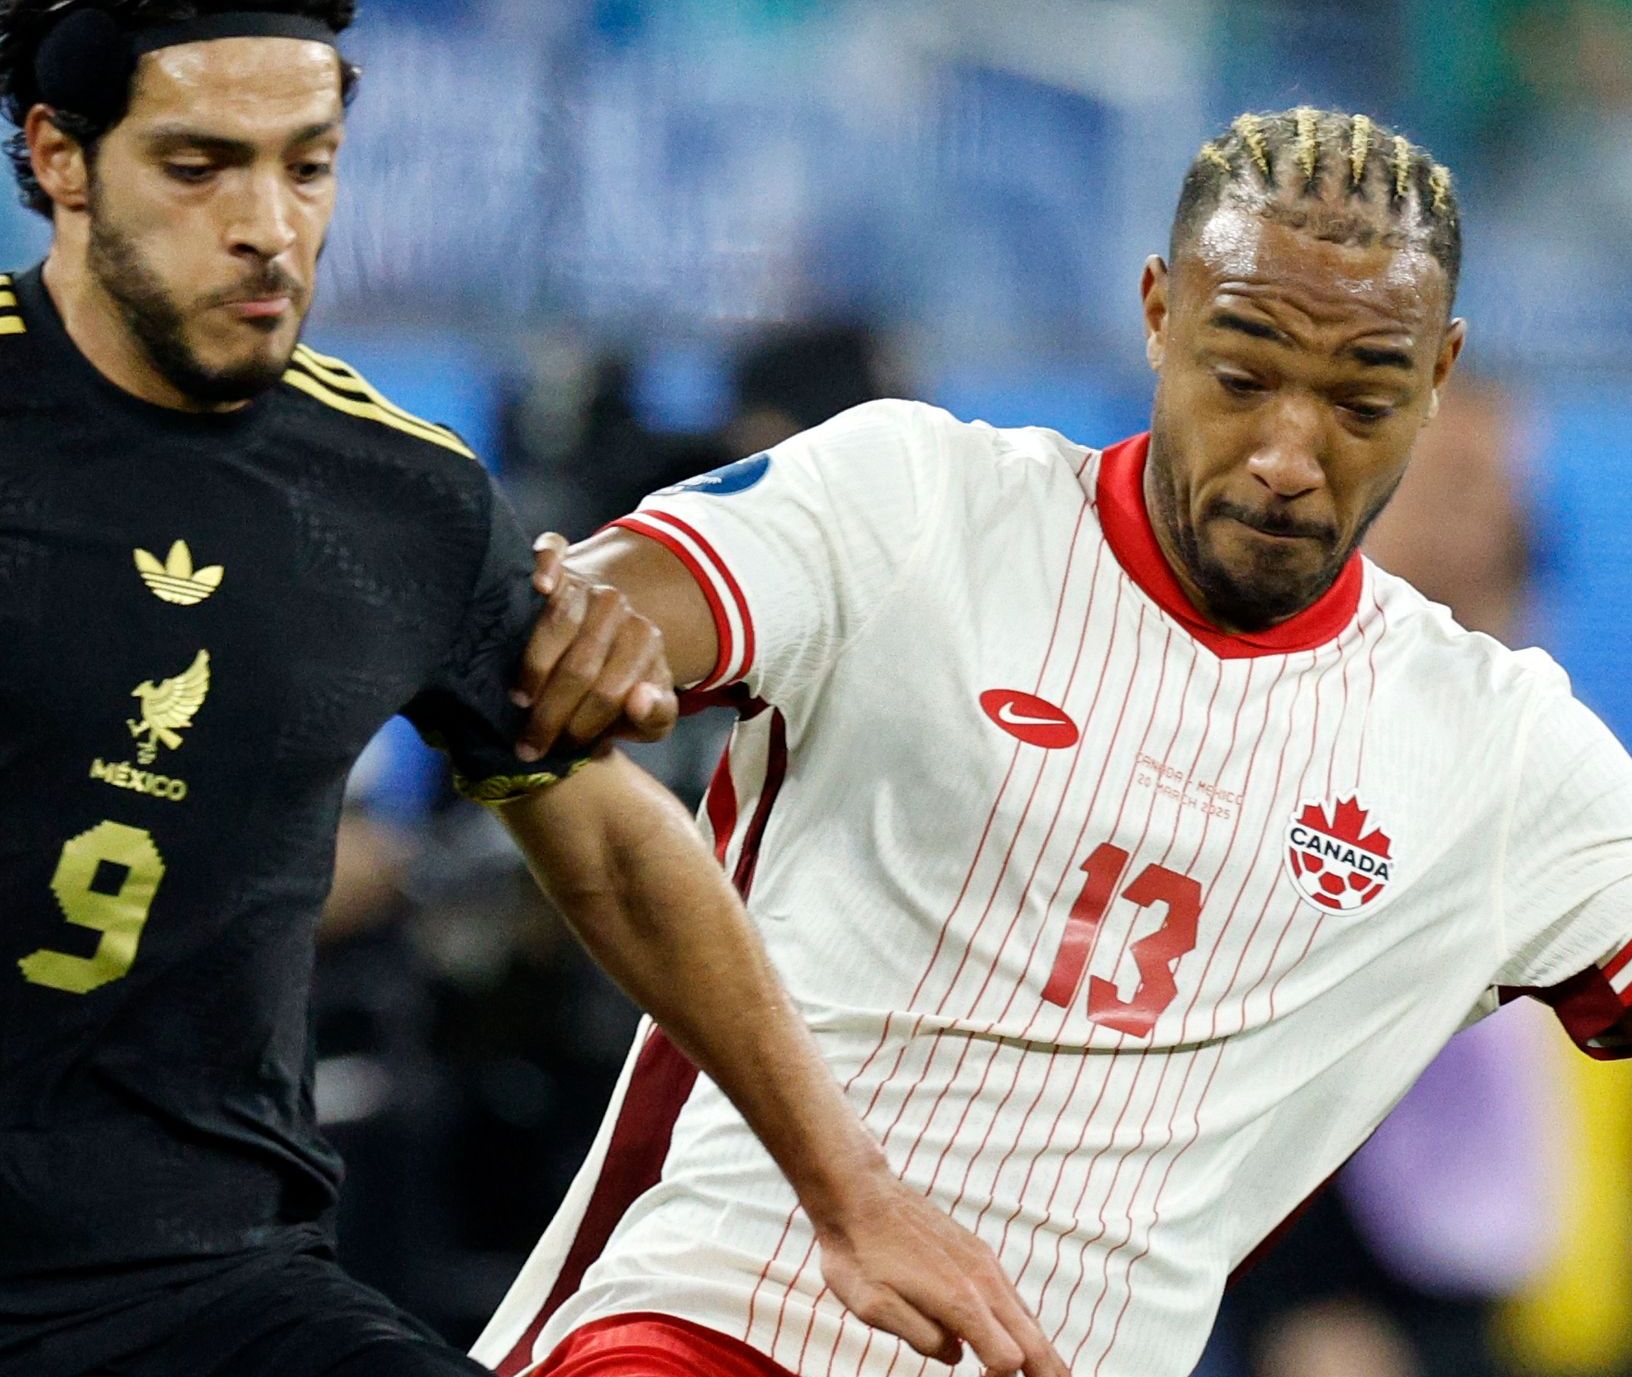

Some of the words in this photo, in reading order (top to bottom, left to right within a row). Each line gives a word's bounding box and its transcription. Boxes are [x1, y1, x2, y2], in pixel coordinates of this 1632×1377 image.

[17, 820, 166, 994] 9
[1040, 842, 1202, 1039] 13
[1290, 827, 1389, 881] CANADA
